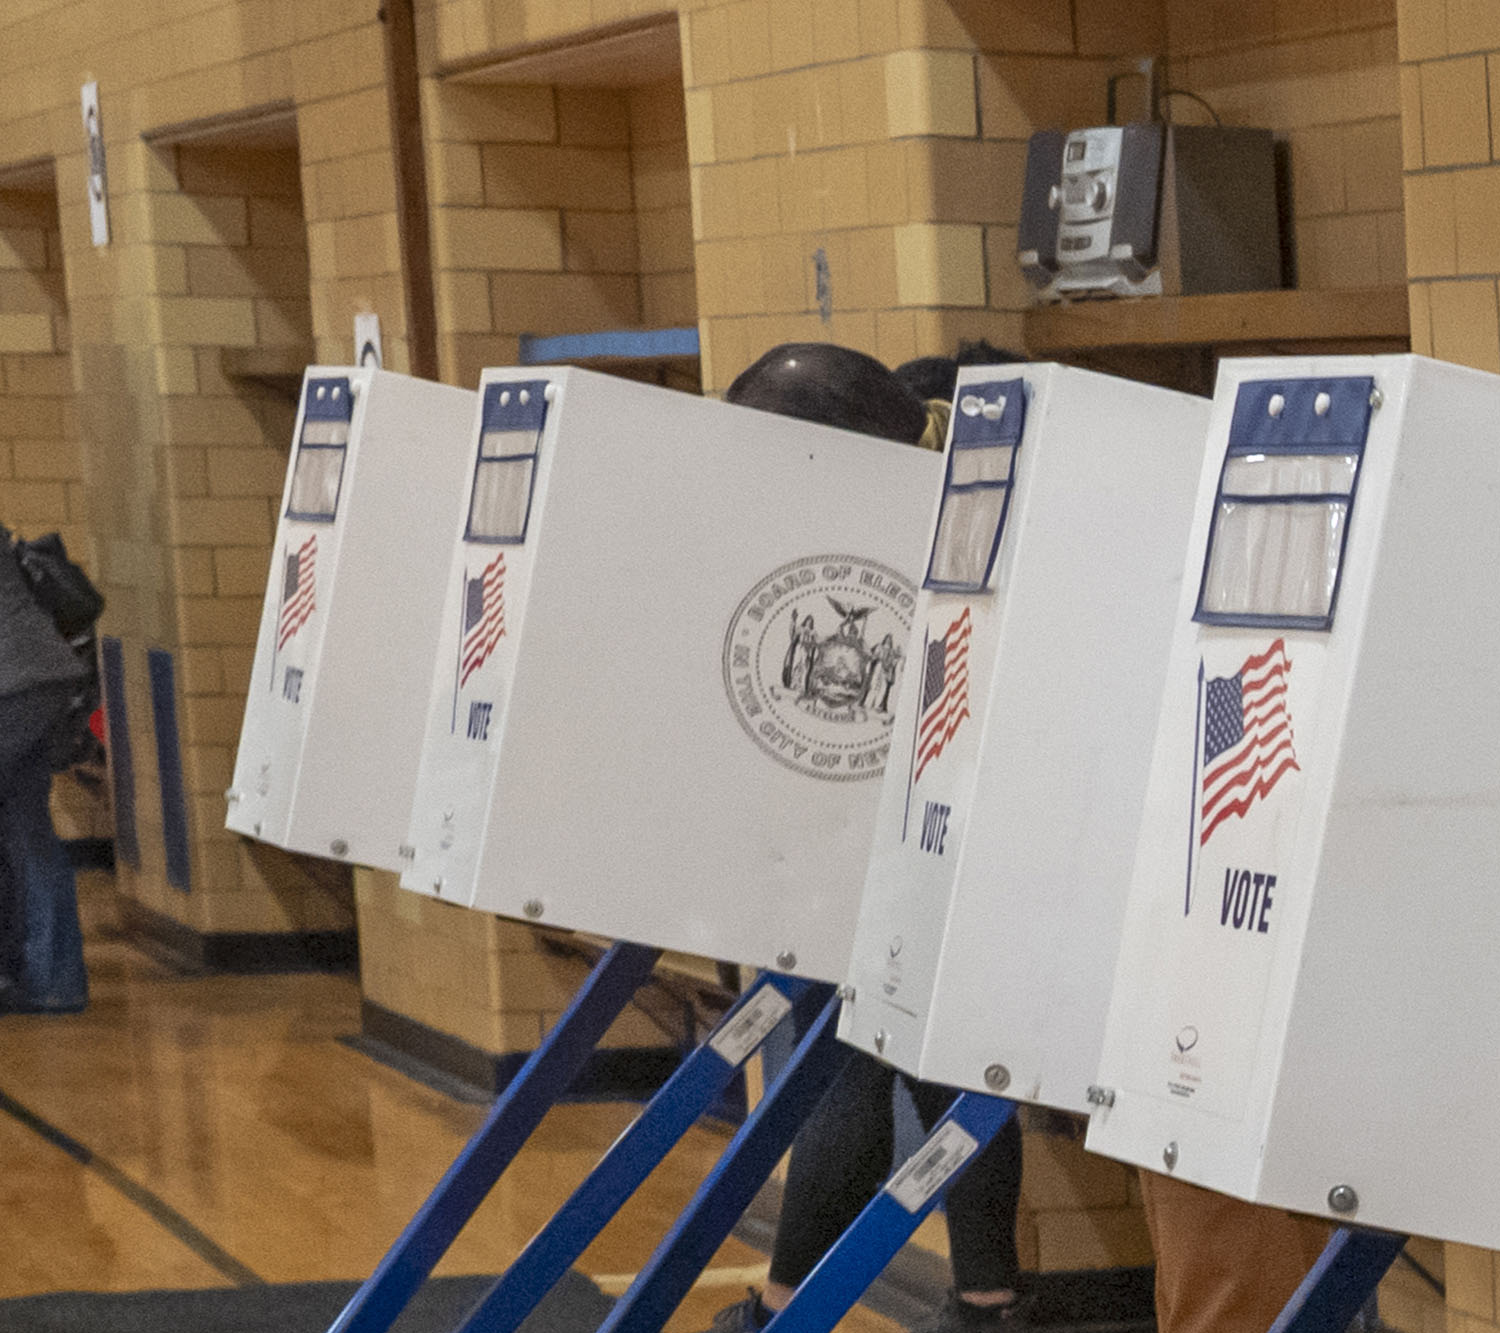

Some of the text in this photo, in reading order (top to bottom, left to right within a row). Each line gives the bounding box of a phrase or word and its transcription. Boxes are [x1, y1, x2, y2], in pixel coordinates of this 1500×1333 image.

[747, 565, 916, 623] BOARD OF ELEC
[733, 644, 750, 667] IN
[735, 673, 763, 718] THE
[467, 701, 493, 741] VOTE
[759, 719, 808, 759] CITY
[811, 752, 842, 768] OF
[920, 801, 951, 855] VOTE
[1220, 867, 1277, 934] VOTE
